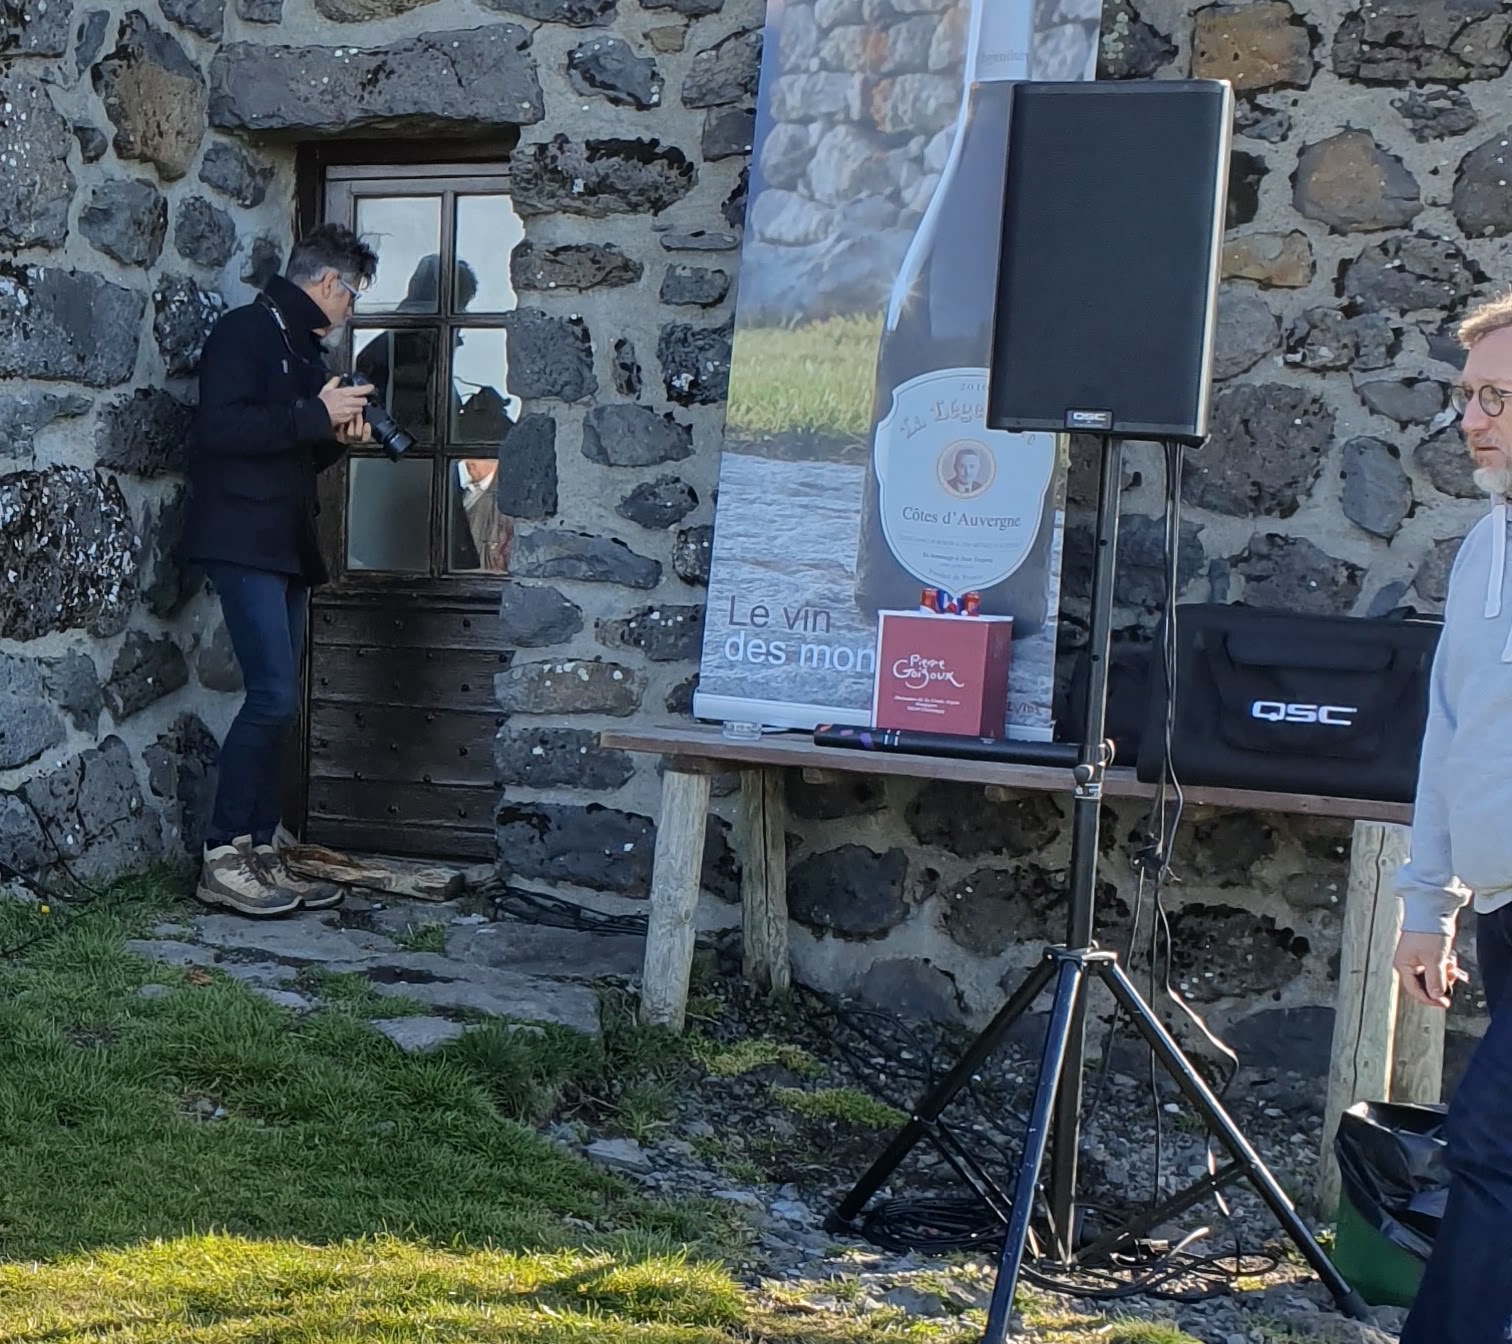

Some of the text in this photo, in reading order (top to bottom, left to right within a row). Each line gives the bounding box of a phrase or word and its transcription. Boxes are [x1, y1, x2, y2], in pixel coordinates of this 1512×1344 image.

[934, 398, 985, 423] Lége
[902, 506, 1021, 531] Côtes d'Auvergne
[728, 595, 832, 634] Le vin
[724, 630, 876, 673] des mon
[909, 654, 946, 670] Pierre
[1251, 701, 1358, 726] QSC
